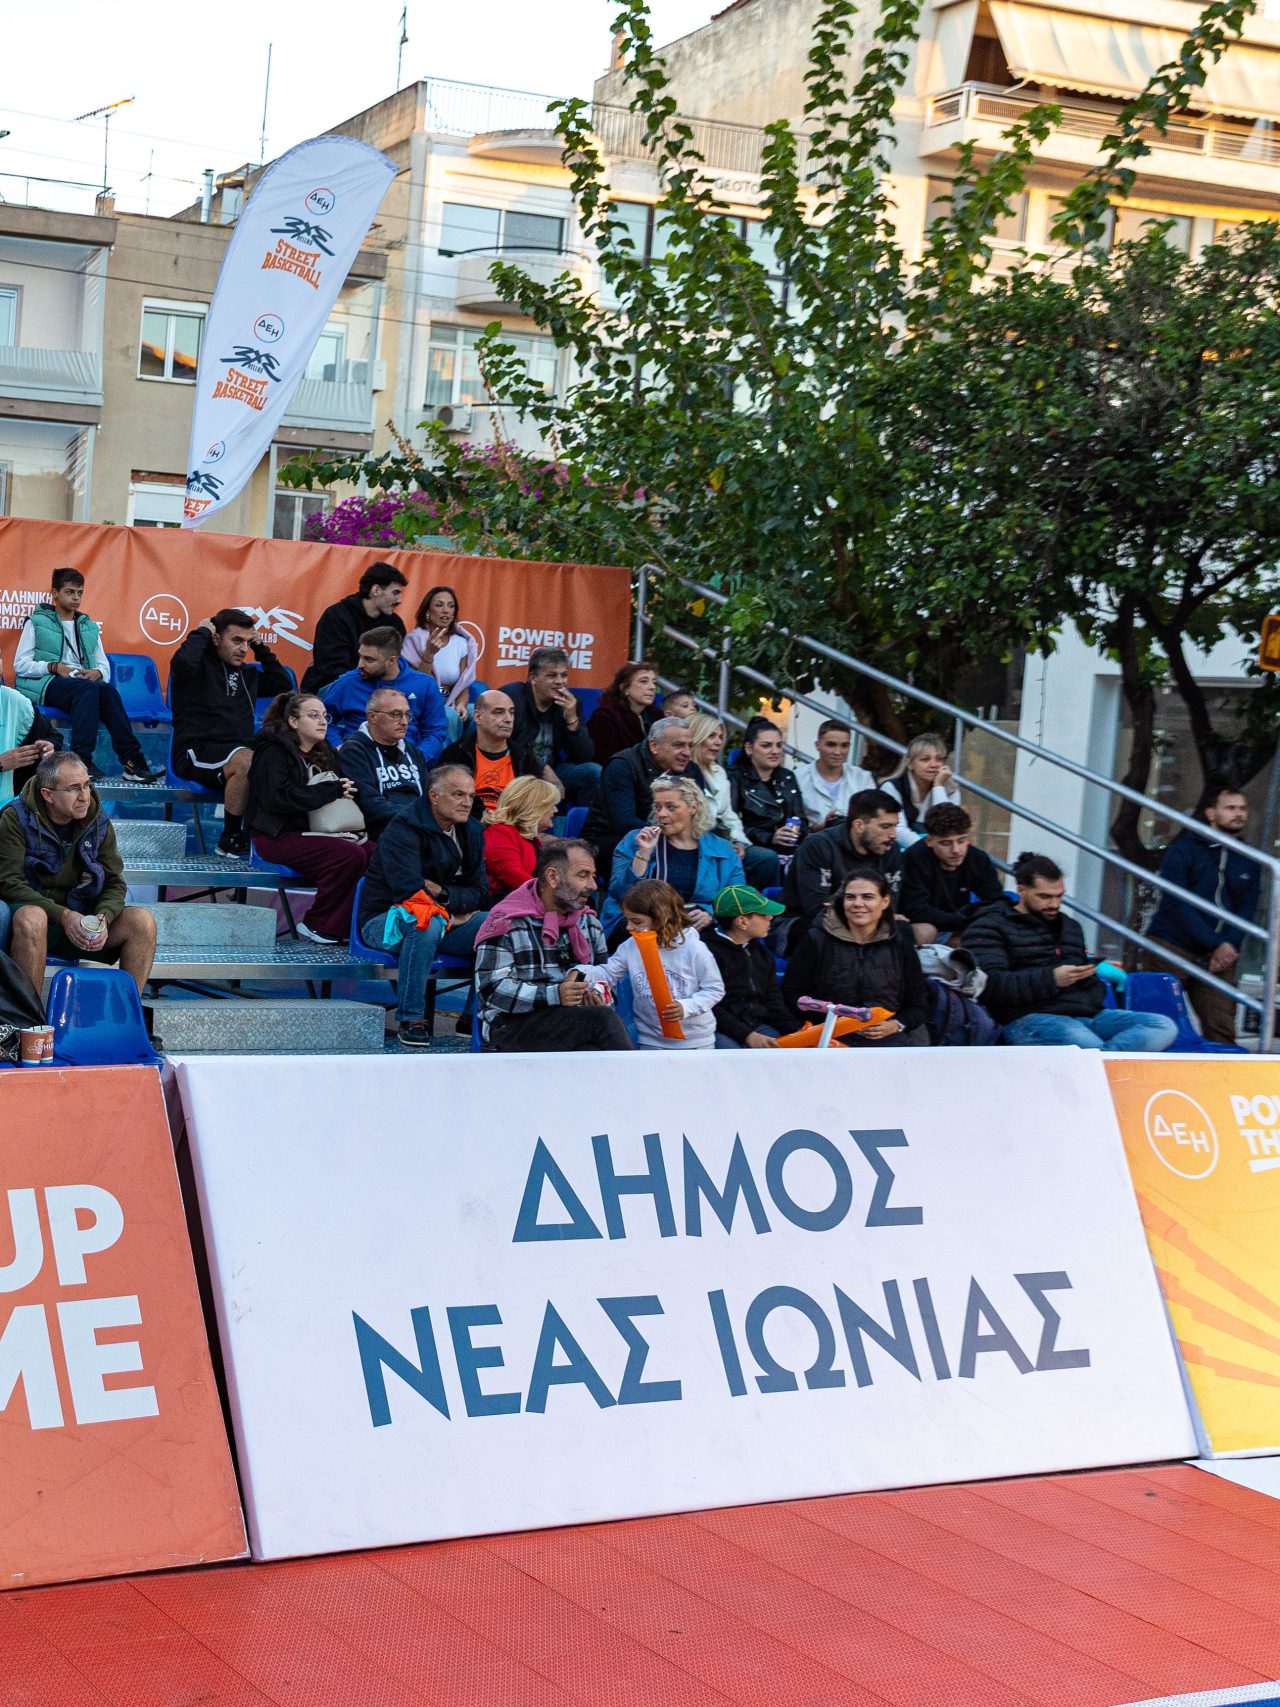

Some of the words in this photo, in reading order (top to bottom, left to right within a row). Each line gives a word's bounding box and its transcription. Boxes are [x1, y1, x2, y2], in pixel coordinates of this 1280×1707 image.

[310, 192, 330, 211] ΔΕΗ
[276, 239, 321, 267] STREET
[261, 252, 321, 289] BASKETBALL
[258, 319, 280, 338] ΔΕΗ
[226, 367, 269, 395] STREET
[212, 381, 269, 411] BASKETBALL
[145, 607, 182, 632] ΔΕΗ
[498, 626, 565, 648] POWER
[567, 632, 595, 649] UP
[497, 644, 530, 660] THE
[376, 764, 419, 782] BOSS
[1153, 1114, 1211, 1153] ΔΕΗ
[1240, 1129, 1280, 1155] TH
[512, 1128, 923, 1243] ΔΗΜΟΣ
[351, 1295, 682, 1427] ΝΕΑΣ
[707, 1271, 1091, 1398] ΙΩΝΙΑΣ
